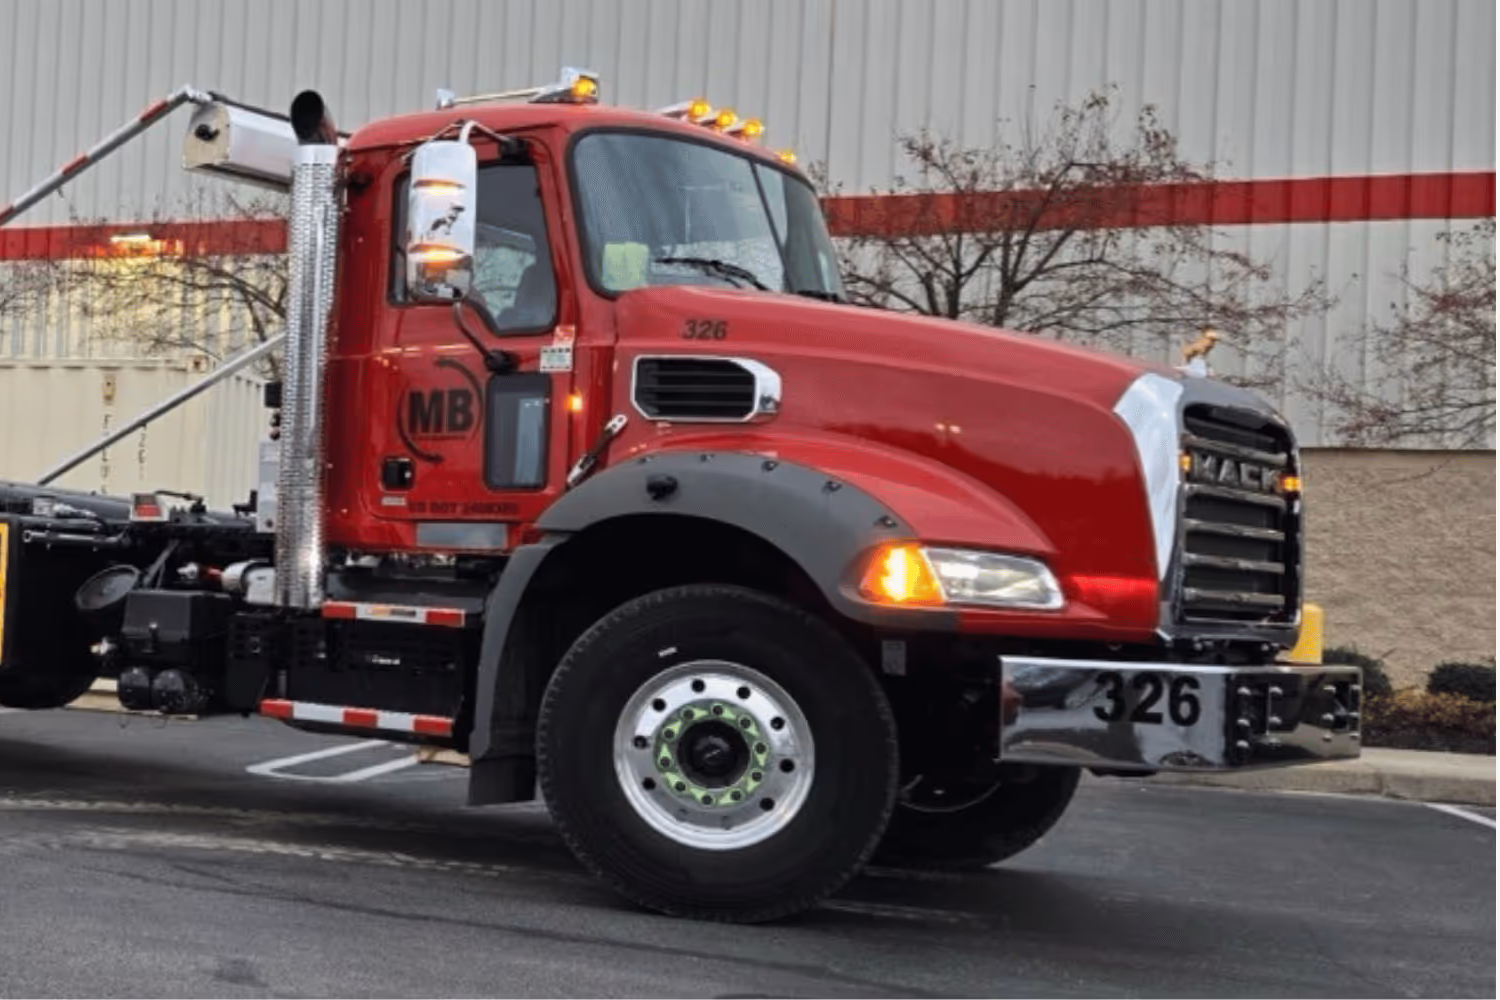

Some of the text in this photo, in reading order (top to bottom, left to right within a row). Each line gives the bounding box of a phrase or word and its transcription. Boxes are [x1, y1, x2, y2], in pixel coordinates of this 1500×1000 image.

[682, 319, 729, 340] 326
[408, 388, 474, 434] MB
[1193, 452, 1280, 490] MACK
[1093, 671, 1202, 727] 326
